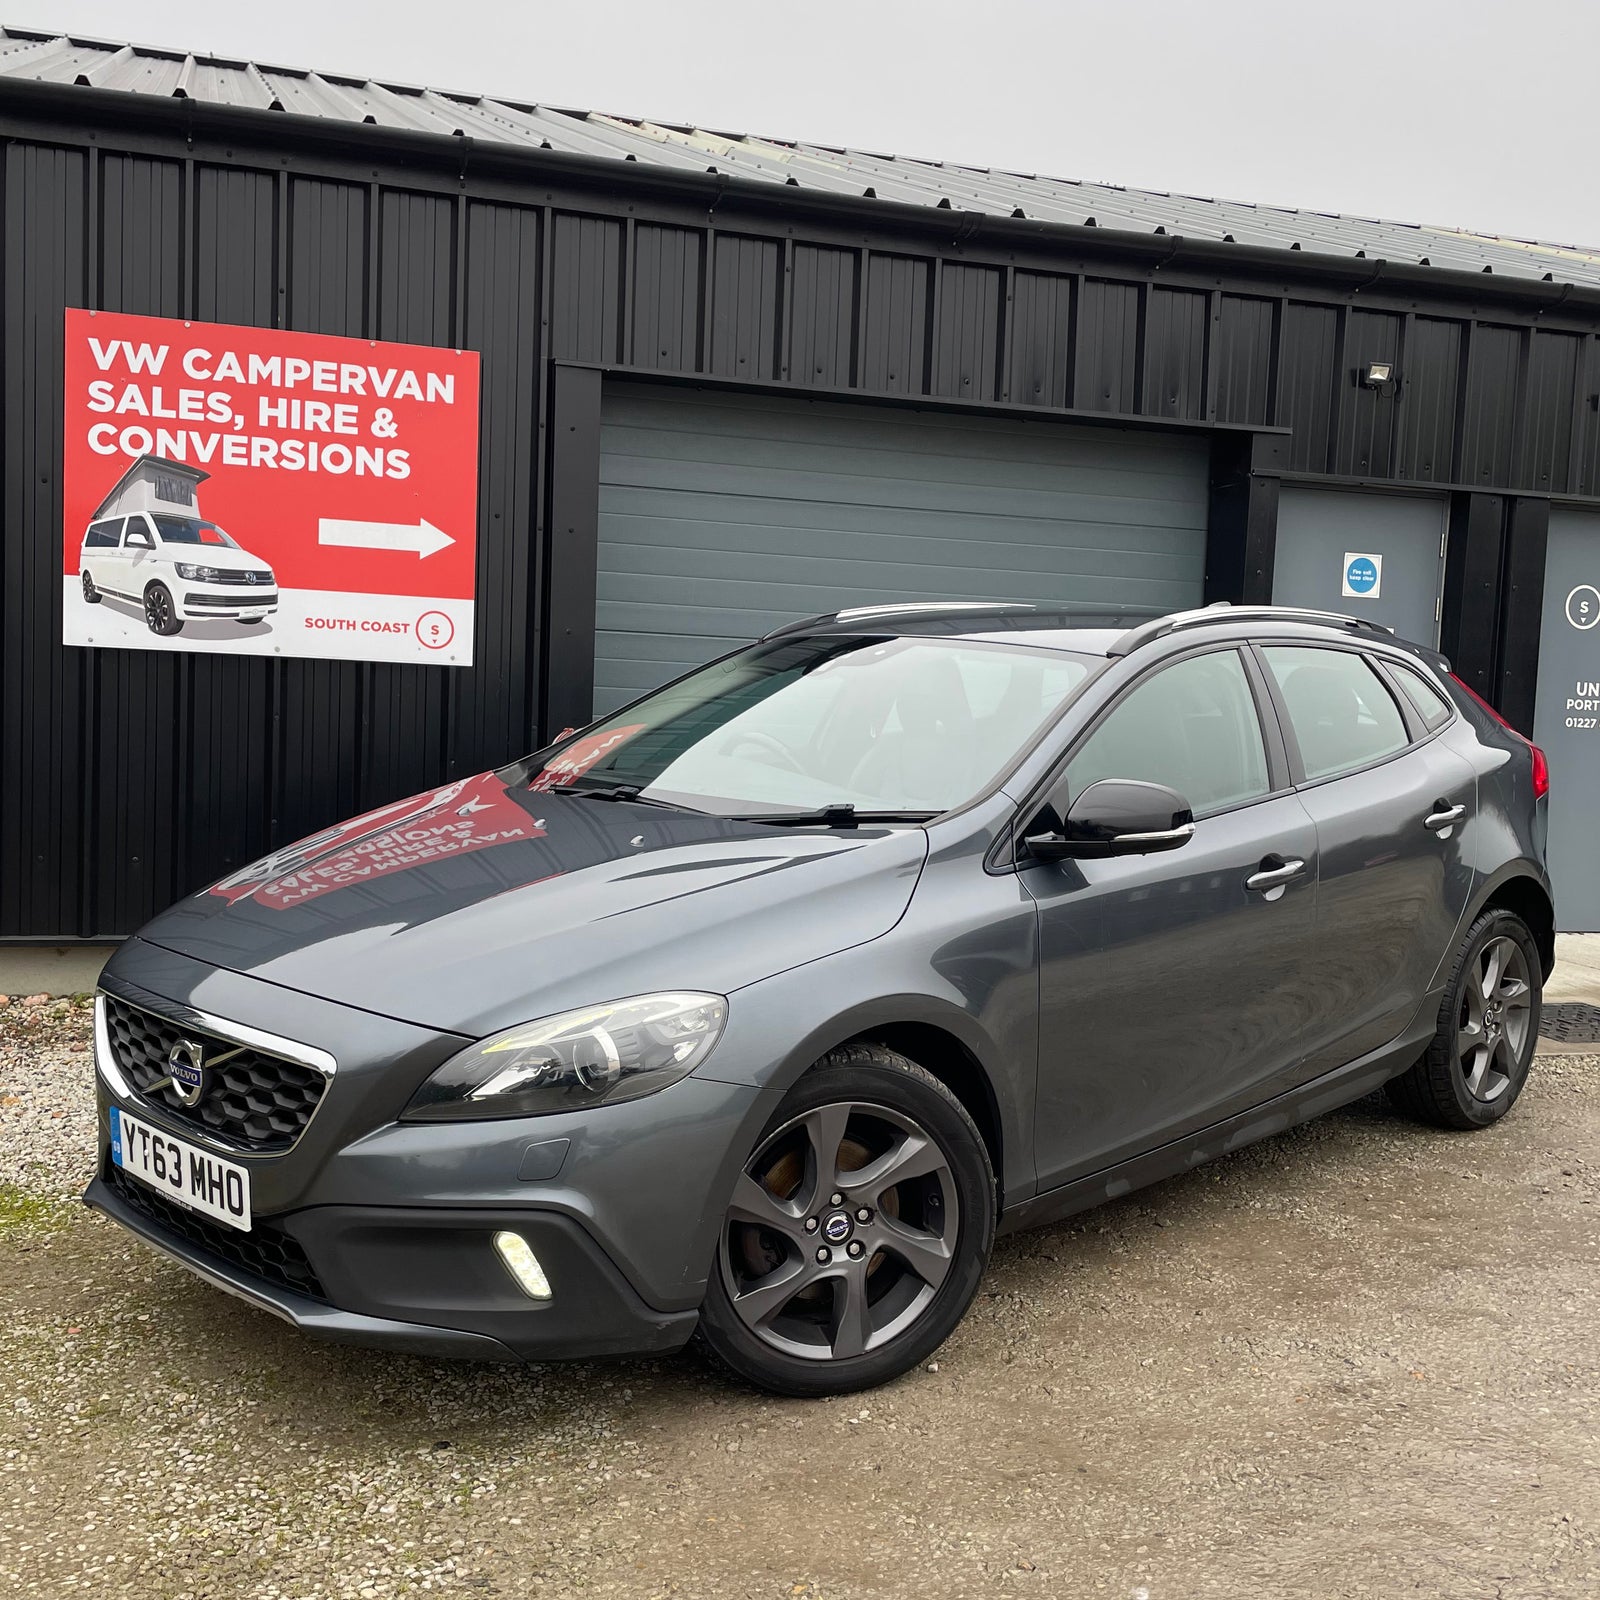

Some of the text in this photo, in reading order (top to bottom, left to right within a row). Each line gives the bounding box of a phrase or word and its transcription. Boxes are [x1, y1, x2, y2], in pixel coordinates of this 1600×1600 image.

[87, 337, 455, 404] VW CAMPERVAN
[87, 380, 399, 439] SALES, HIRE &
[87, 422, 411, 480] CONVERSIONS
[1579, 601, 1589, 613] S
[304, 617, 411, 634] SOUTH COAST
[430, 624, 440, 635] S
[1565, 717, 1597, 728] 01227
[170, 1063, 198, 1082] VOLVO
[123, 1118, 244, 1217] YT63 MHO
